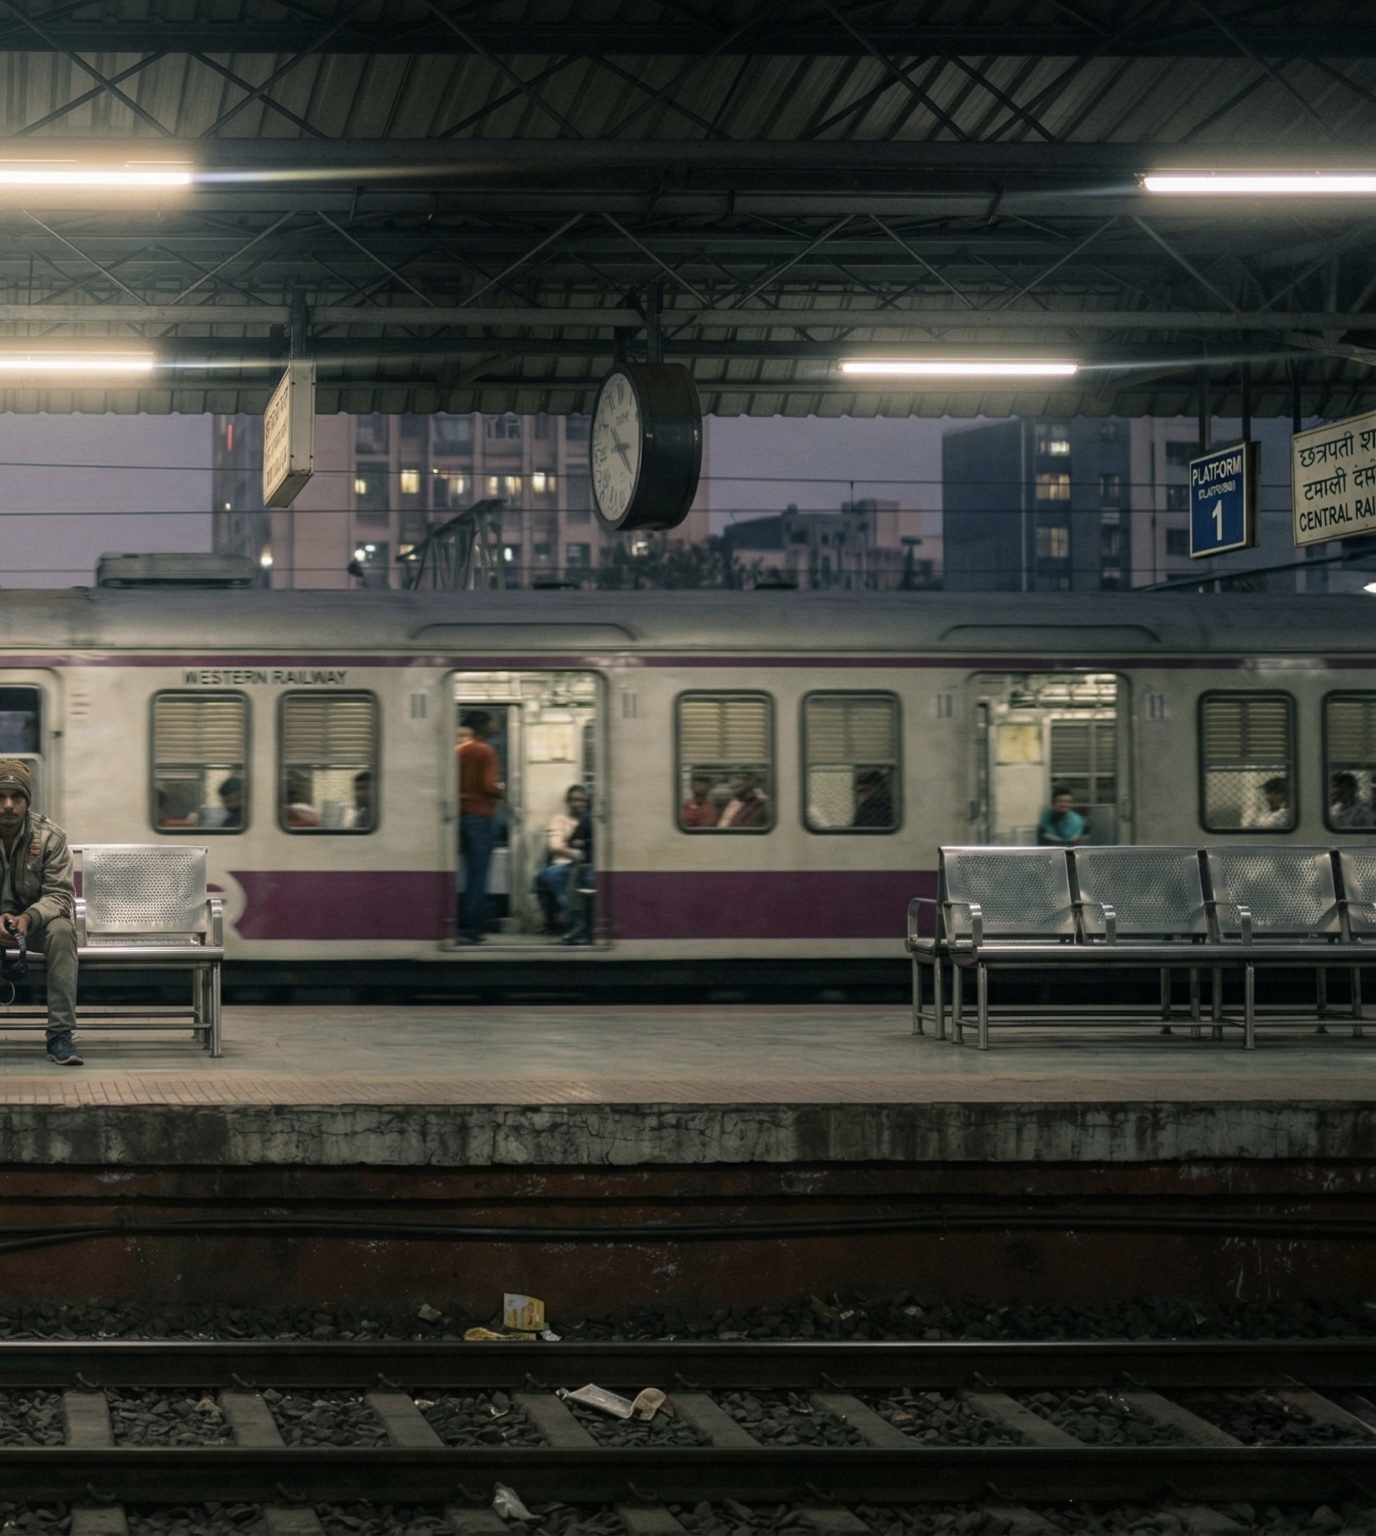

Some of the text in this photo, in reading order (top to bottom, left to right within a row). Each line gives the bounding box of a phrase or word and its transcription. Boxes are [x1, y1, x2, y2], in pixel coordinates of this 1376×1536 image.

[1298, 430, 1354, 468] छत्रपती
[1212, 500, 1223, 541] 1
[1299, 502, 1353, 532] CENTRAL
[183, 670, 349, 685] WESTERN RAILWAY
